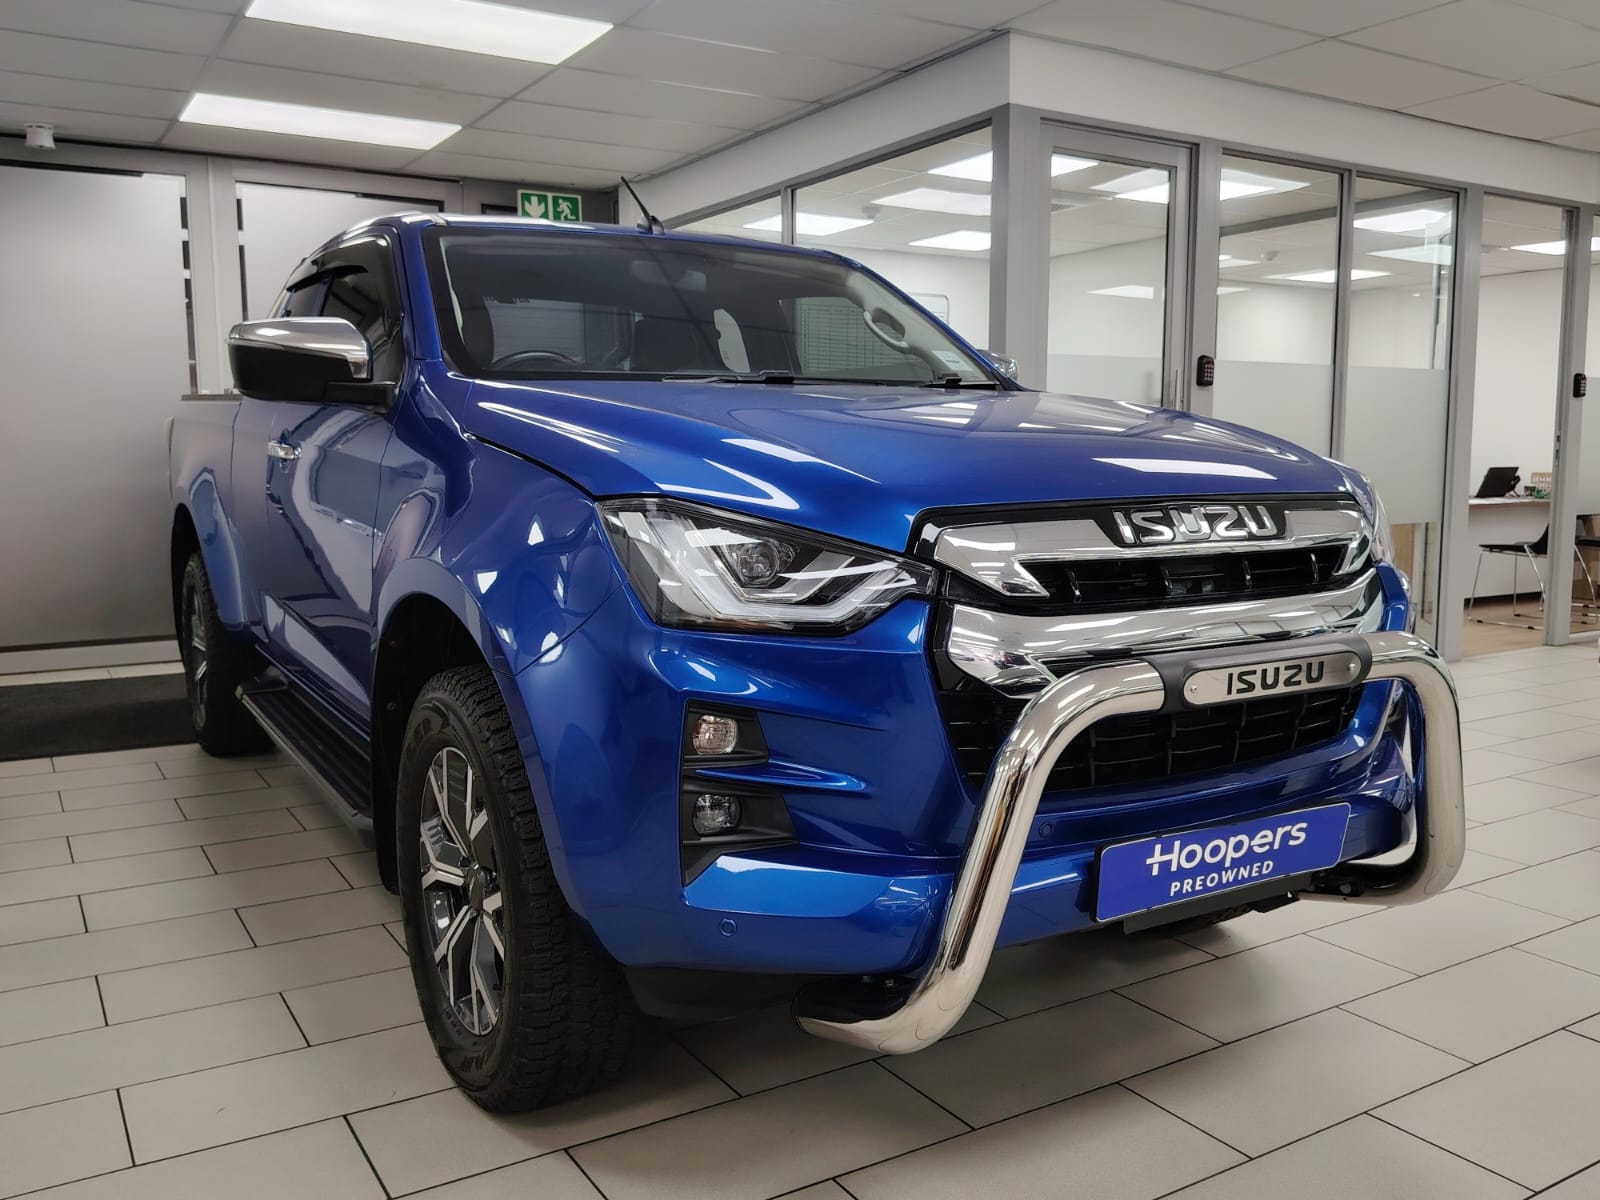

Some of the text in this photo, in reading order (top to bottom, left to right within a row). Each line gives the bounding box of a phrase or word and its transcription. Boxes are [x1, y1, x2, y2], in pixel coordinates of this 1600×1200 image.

[1113, 504, 1277, 543] ISUZU
[1227, 661, 1324, 696] ISUZU
[1146, 822, 1308, 876] Hoopers
[1170, 860, 1274, 896] PREOWNED
